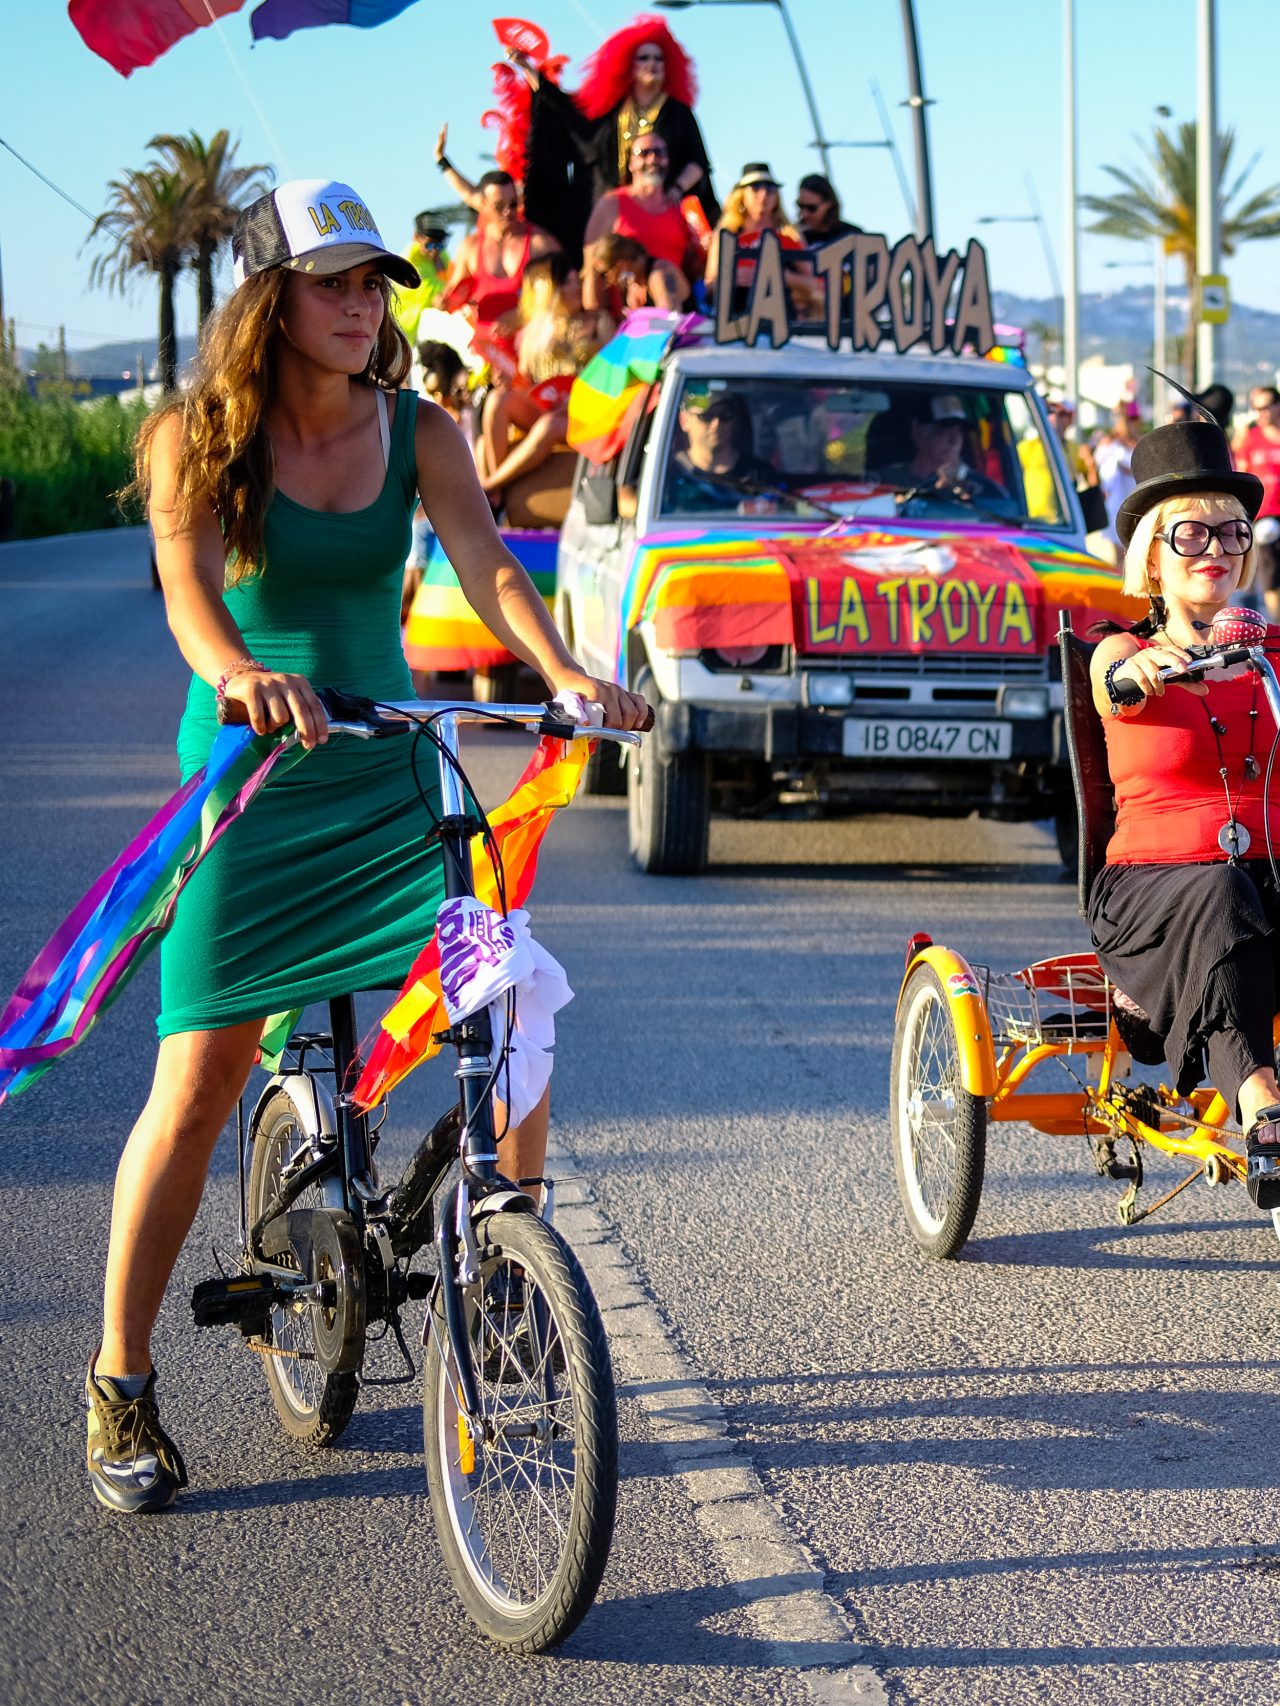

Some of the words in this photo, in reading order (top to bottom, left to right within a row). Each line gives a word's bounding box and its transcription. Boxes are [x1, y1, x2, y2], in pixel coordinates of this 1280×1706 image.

[308, 203, 341, 236] LA
[715, 228, 789, 348] LA
[814, 232, 996, 355] TROYA
[806, 576, 870, 645] LA
[876, 577, 1034, 645] TROYA
[863, 725, 890, 751] IB
[897, 726, 961, 752] 0847
[968, 727, 1001, 753] CN
